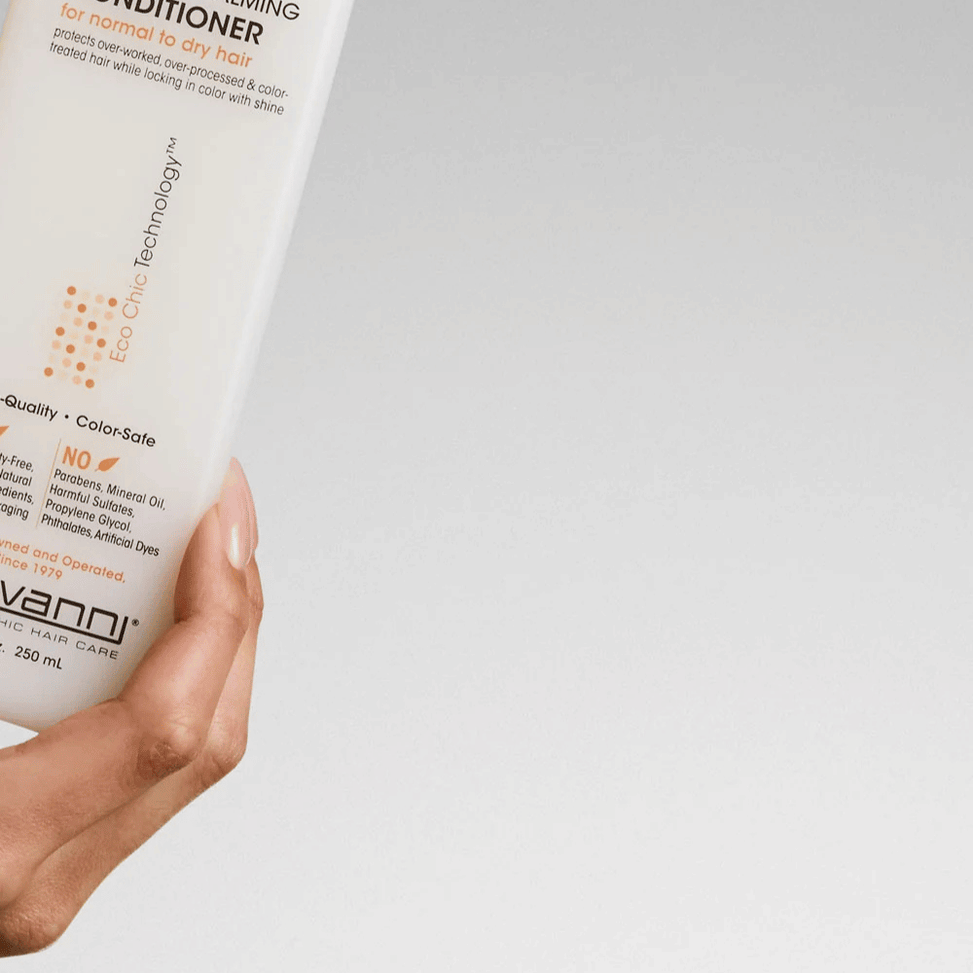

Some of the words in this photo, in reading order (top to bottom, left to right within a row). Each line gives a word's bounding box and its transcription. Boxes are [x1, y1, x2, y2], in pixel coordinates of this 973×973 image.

[60, 2, 85, 22] for
[89, 13, 154, 41] normal
[159, 29, 176, 47] to
[181, 38, 211, 60] dry
[215, 45, 253, 68] hair
[49, 41, 88, 61] treated
[89, 52, 111, 68] hair
[113, 61, 142, 77] while
[143, 67, 183, 91] locking
[185, 78, 196, 92] in
[198, 84, 227, 100] color
[229, 93, 251, 107] with
[253, 98, 284, 115] shine
[53, 27, 96, 47] protects
[97, 40, 162, 67] over-worked,
[164, 58, 246, 88] over-processed
[246, 78, 256, 91] &
[258, 84, 288, 99] color-
[109, 326, 133, 363] Eco
[122, 273, 147, 319] Chic
[76, 414, 156, 447] Color-Safe
[62, 445, 92, 470] NO
[49, 483, 91, 504] Harmful
[92, 495, 135, 518] Sulfates,
[53, 468, 103, 493] Parabens,
[106, 483, 147, 504] Mineral
[149, 495, 165, 511] Oil,
[45, 498, 96, 522] Propylene
[98, 513, 132, 534] Glycol,
[32, 548, 59, 563] and
[135, 540, 160, 557] Dyes
[34, 563, 63, 580] 1979
[14, 645, 40, 662] 250
[42, 656, 62, 670] mL
[30, 627, 68, 645] HAIR
[75, 640, 119, 660] CARE
